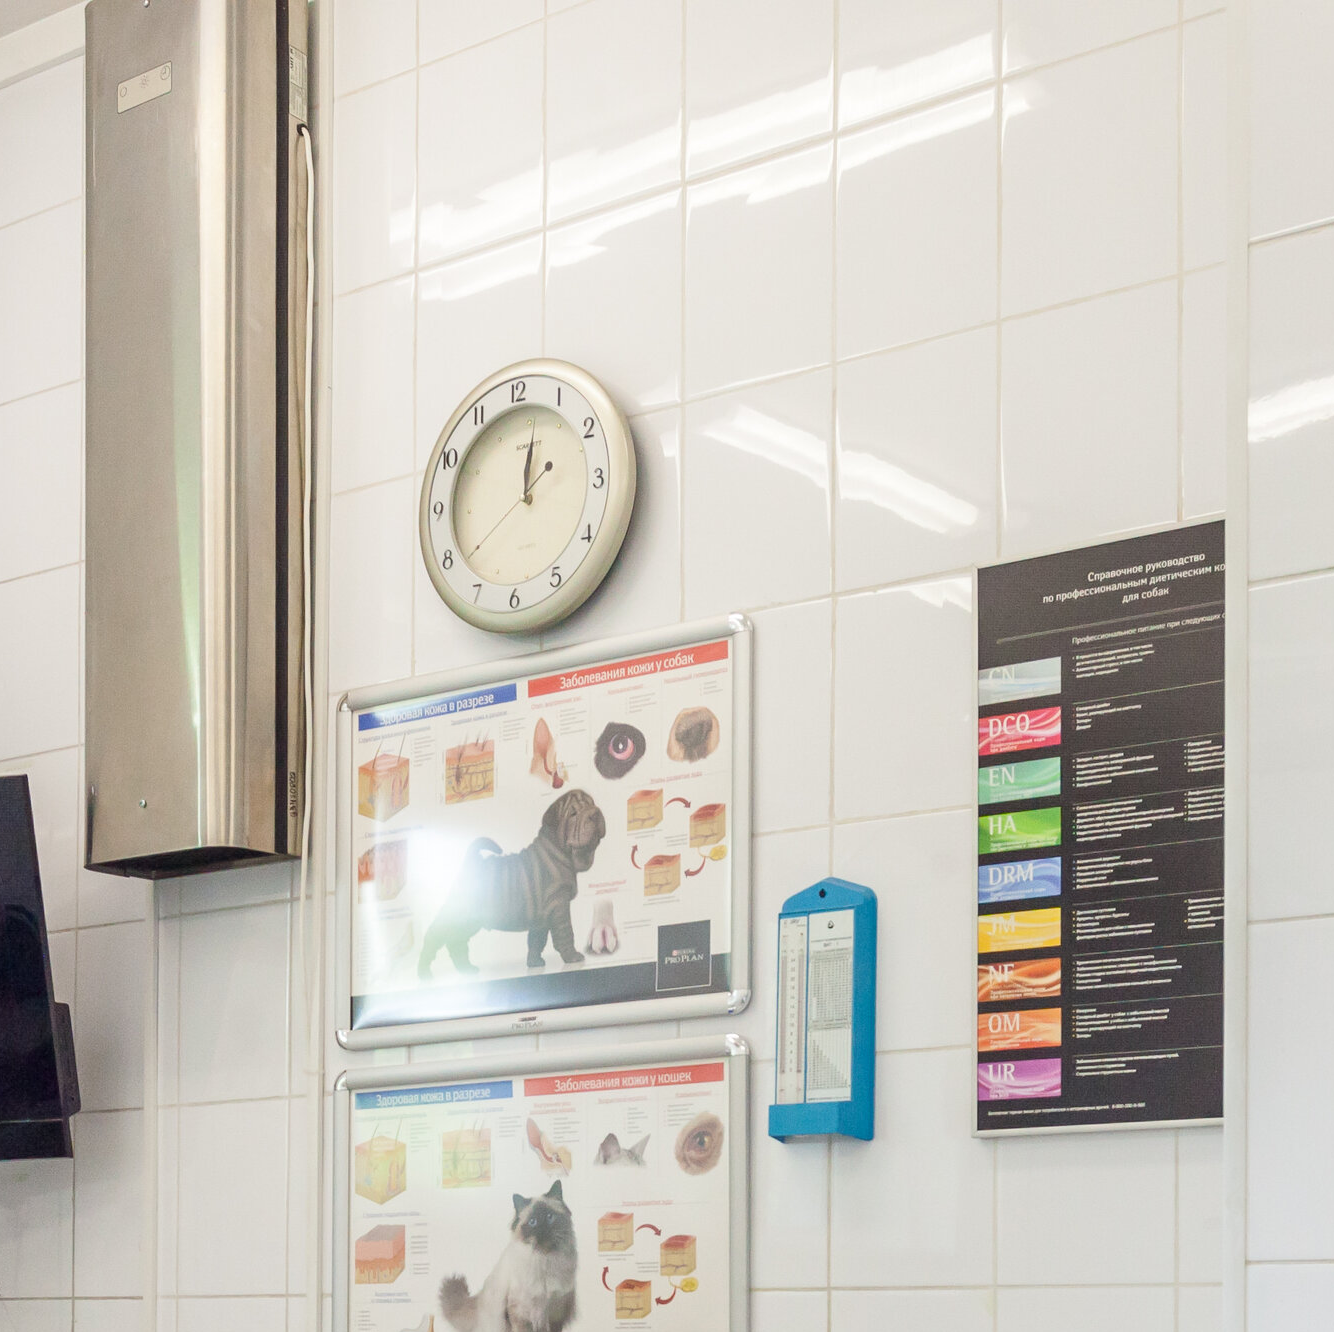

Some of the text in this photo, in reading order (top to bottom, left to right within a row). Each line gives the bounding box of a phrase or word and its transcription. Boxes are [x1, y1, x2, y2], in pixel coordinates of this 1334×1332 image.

[511, 381, 526, 403] 12
[557, 387, 561, 406] 1
[474, 405, 484, 425] 11
[583, 417, 595, 438] 2
[442, 450, 458, 470] 10
[592, 468, 605, 489] 3
[433, 502, 444, 521] 9
[580, 523, 592, 543] 4
[442, 550, 454, 569] 8
[1087, 553, 1205, 581] Справочное руководство
[549, 566, 562, 588] 5
[1043, 566, 1211, 605] по профессиональным диетическим
[472, 583, 483, 604] 7
[509, 588, 520, 608] 6
[1121, 586, 1168, 603] для собак
[559, 656, 694, 691] Заболевания кожи у собак
[380, 697, 494, 726] Здоровая кожа в разрезе
[988, 714, 1030, 738] DCO
[988, 765, 1016, 787] EN
[988, 817, 1016, 835] HA
[988, 863, 1034, 886] DRM
[988, 964, 1014, 983] NF
[988, 1013, 1020, 1033] OM
[555, 1072, 691, 1092] Заболевания кожи у кошек
[987, 1063, 1015, 1082] UR
[376, 1090, 490, 1106] Здоровая кожа в разрезе
